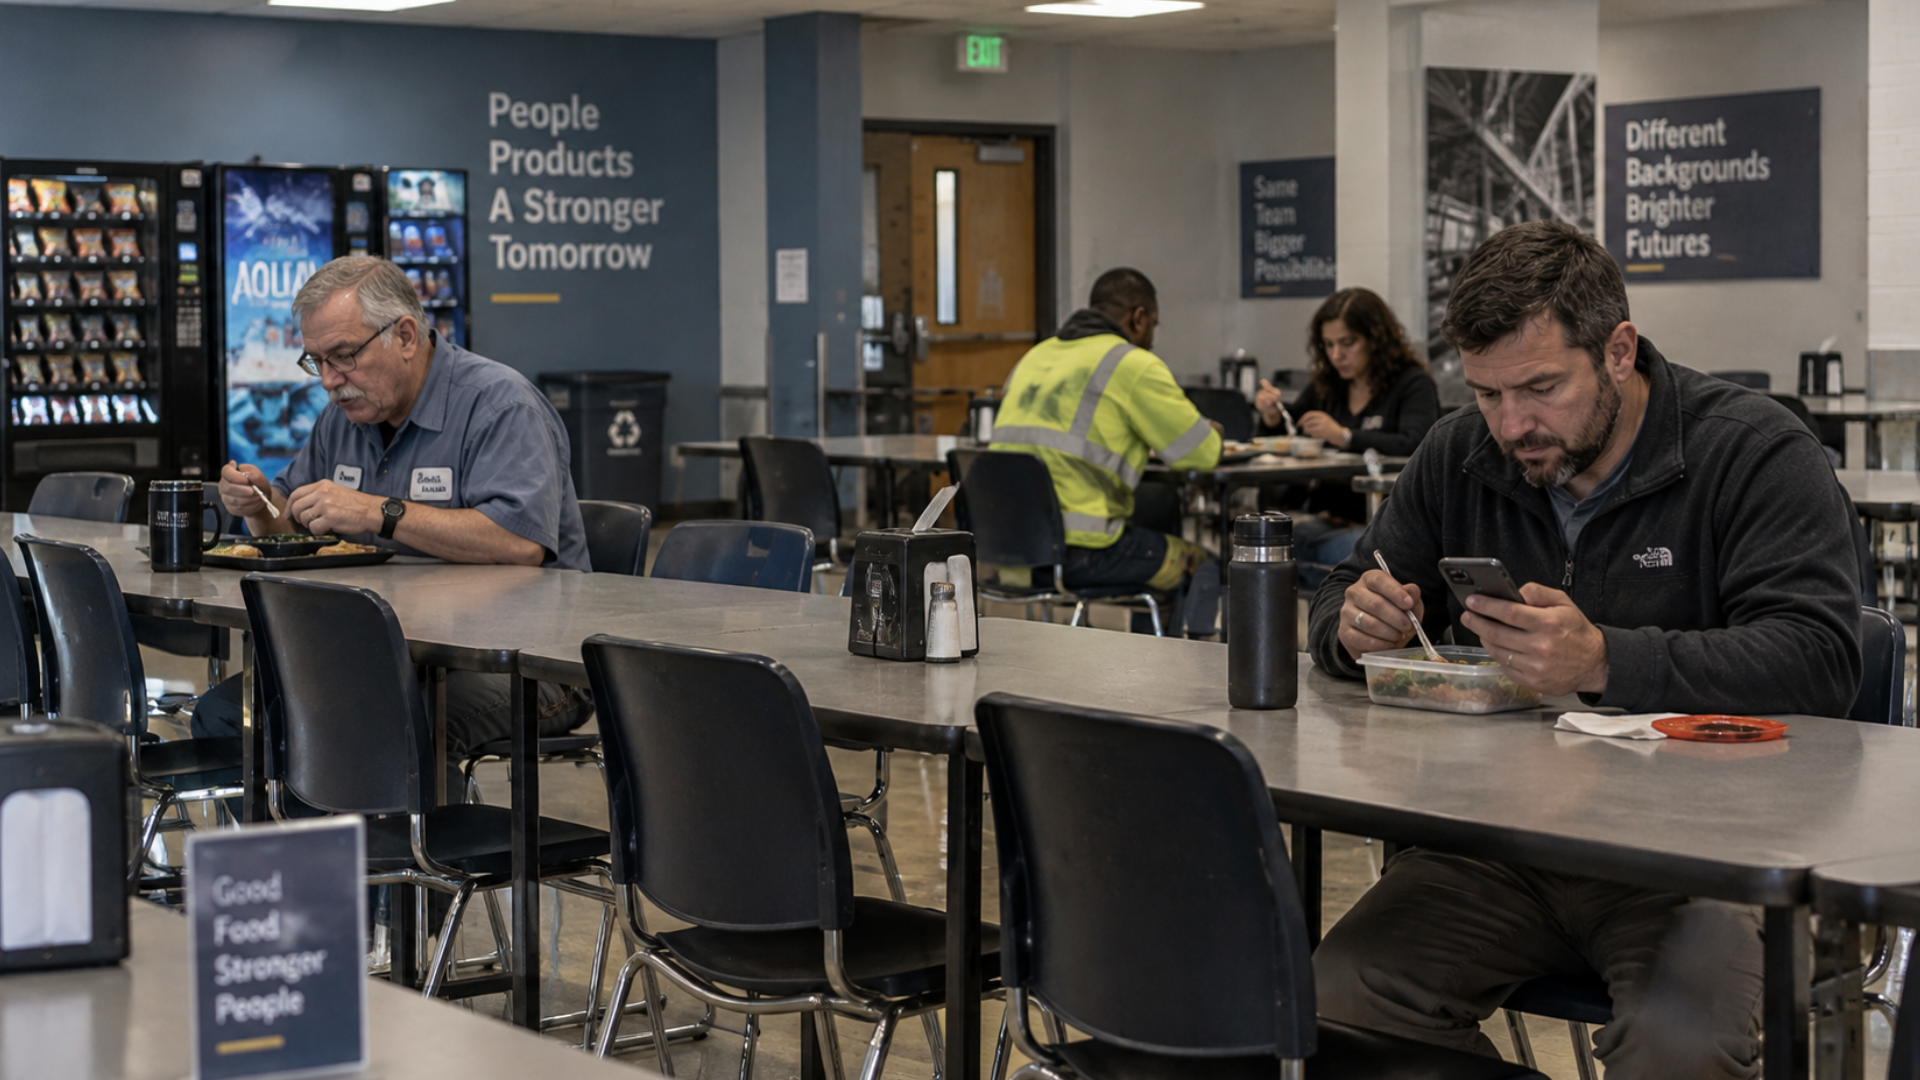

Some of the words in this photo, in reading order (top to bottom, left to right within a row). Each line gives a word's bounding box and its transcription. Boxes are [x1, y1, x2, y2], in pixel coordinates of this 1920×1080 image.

[966, 35, 1002, 67] EXIT
[489, 91, 600, 137] People
[1625, 118, 1727, 151] Different
[489, 139, 634, 178] Products
[1625, 149, 1771, 191] Backgrounds
[1254, 174, 1299, 199] Same
[488, 187, 514, 223] A
[523, 187, 664, 233] Stronger
[1254, 202, 1297, 226] Team
[1625, 190, 1715, 229] Brighter
[489, 233, 653, 271] Tomorrow
[1254, 229, 1306, 259] Bigger
[1625, 229, 1711, 259] Futures
[212, 869, 283, 907] Good
[213, 909, 280, 947] Food
[214, 949, 327, 987] Stronger
[214, 985, 305, 1025] People
